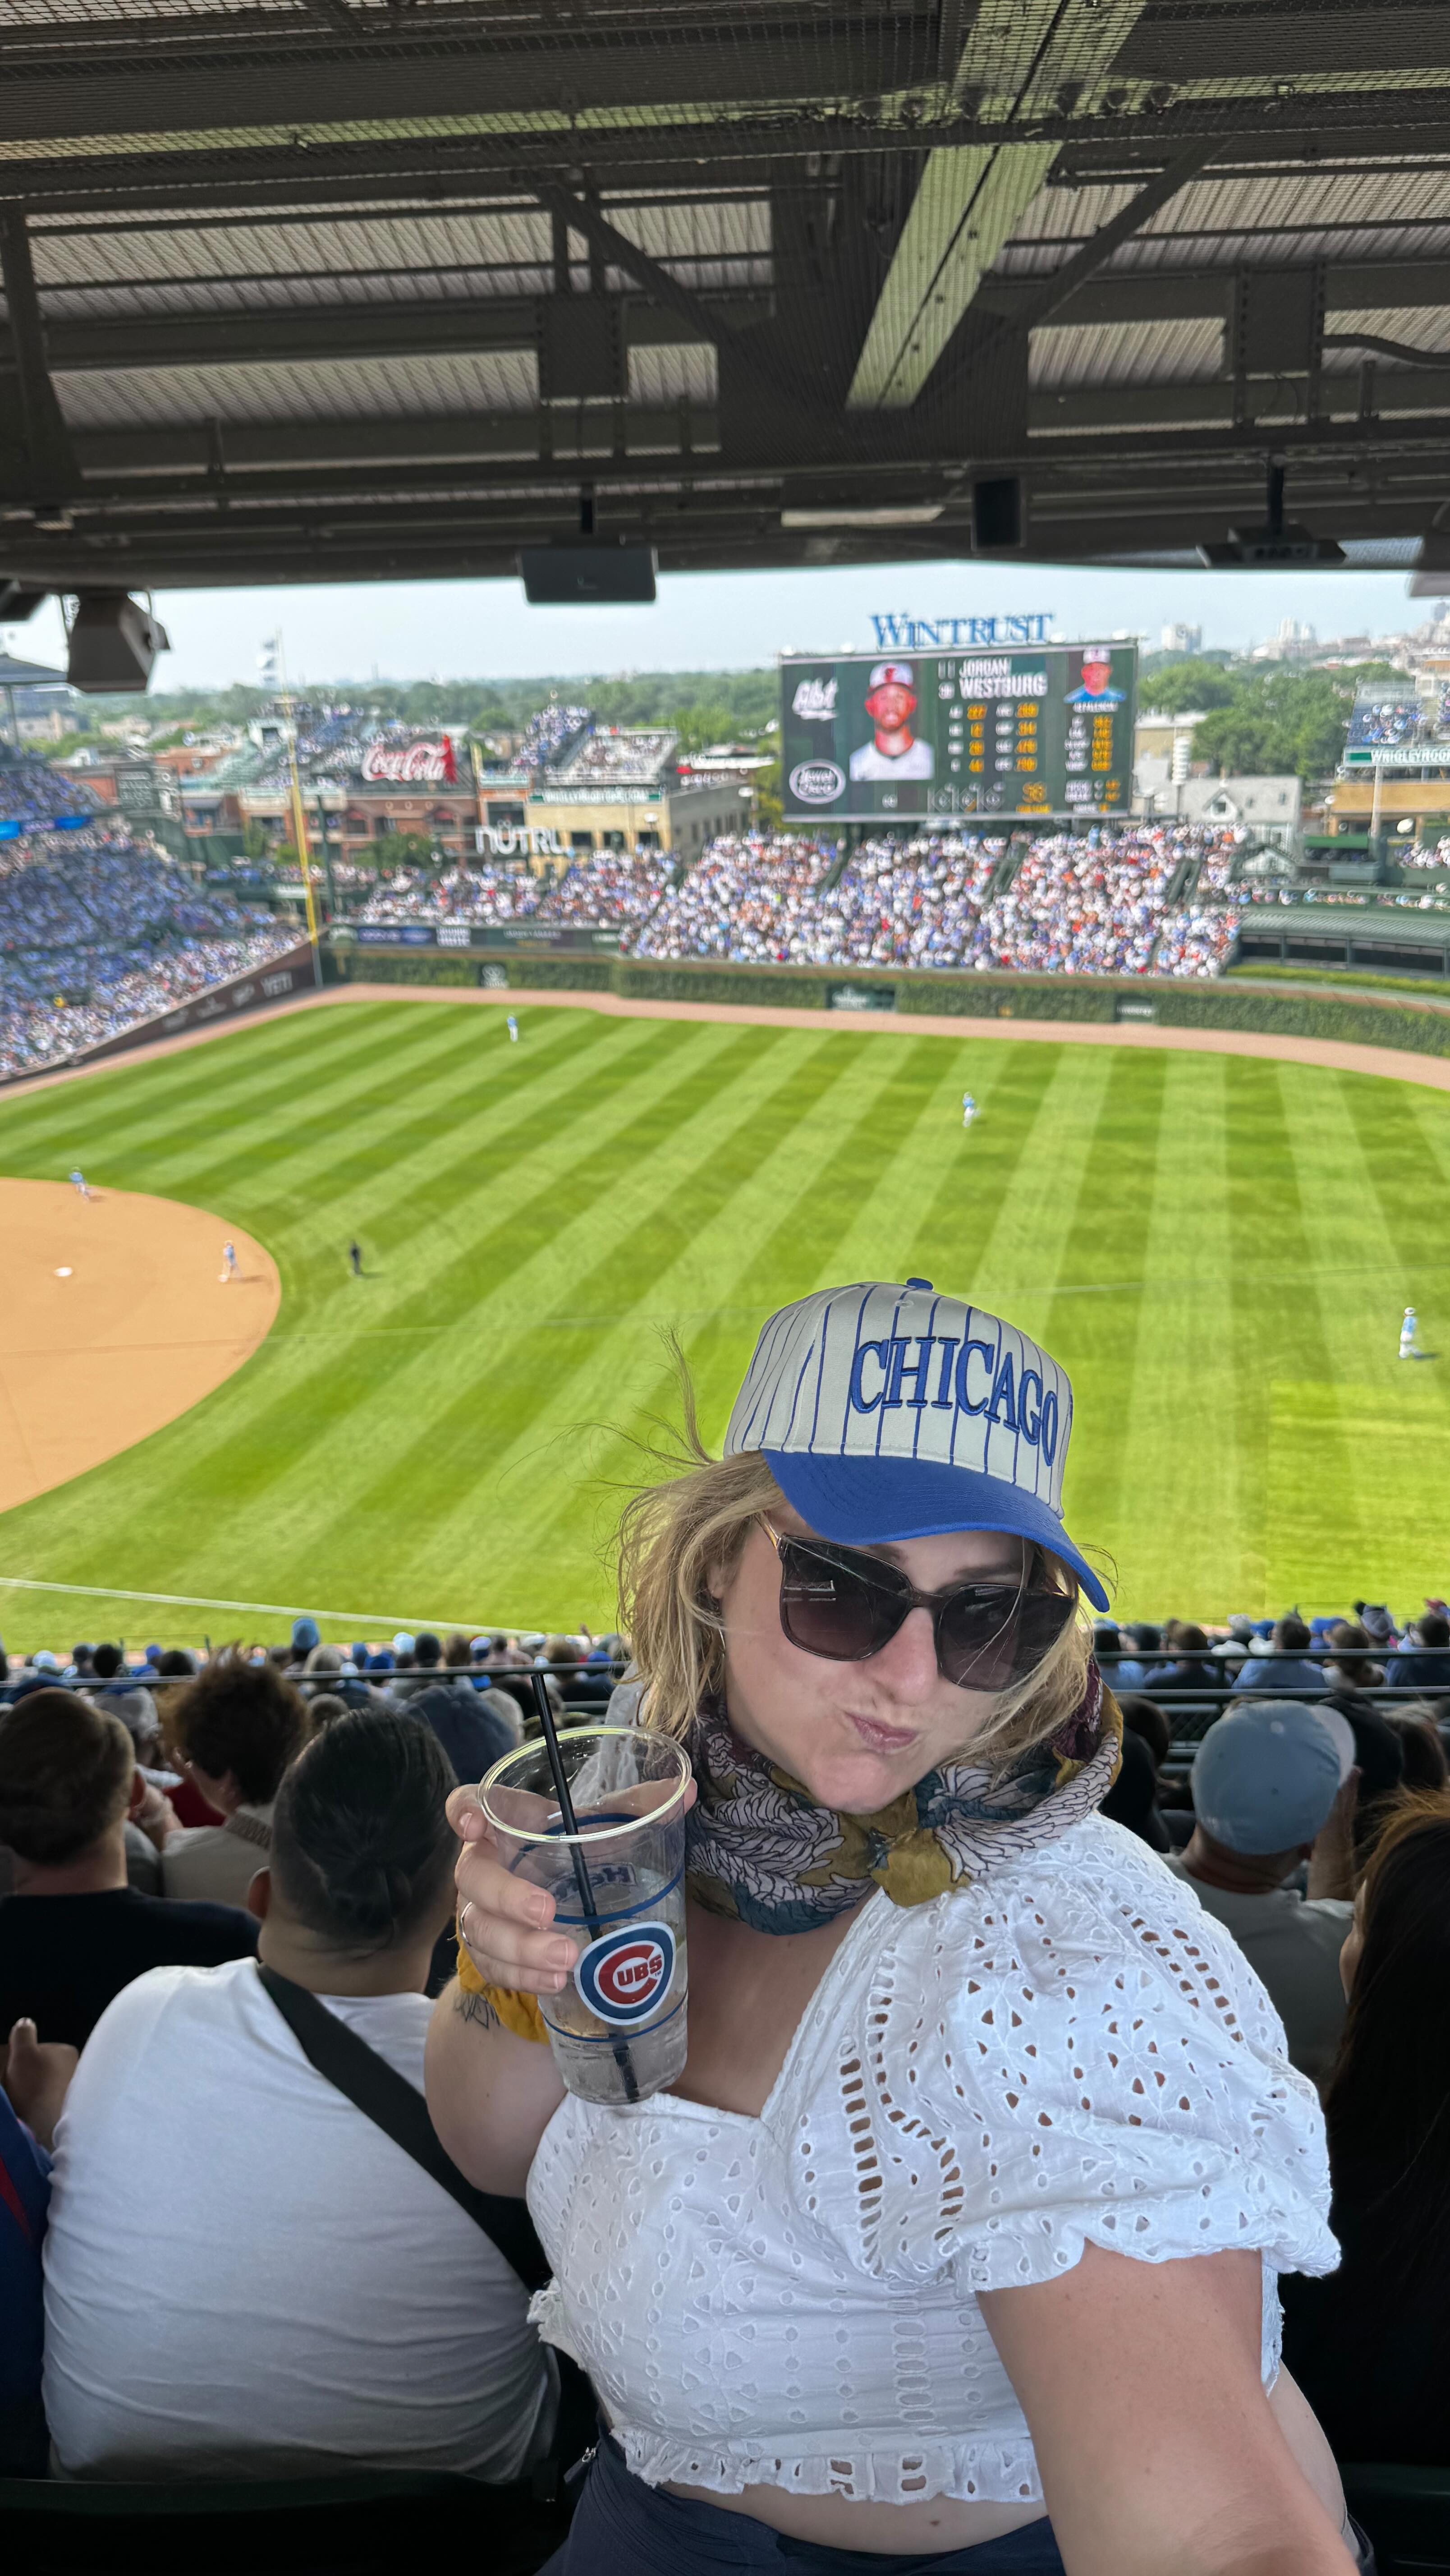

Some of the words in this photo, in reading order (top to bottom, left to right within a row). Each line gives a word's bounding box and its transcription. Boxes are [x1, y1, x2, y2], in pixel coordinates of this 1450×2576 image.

[871, 614, 1053, 647] WINTRUST
[959, 657, 1012, 677] JORDAN
[959, 672, 1048, 699] WESTBURG
[362, 742, 450, 781] Coca-Cola
[851, 1336, 1059, 1466] CHICAGO
